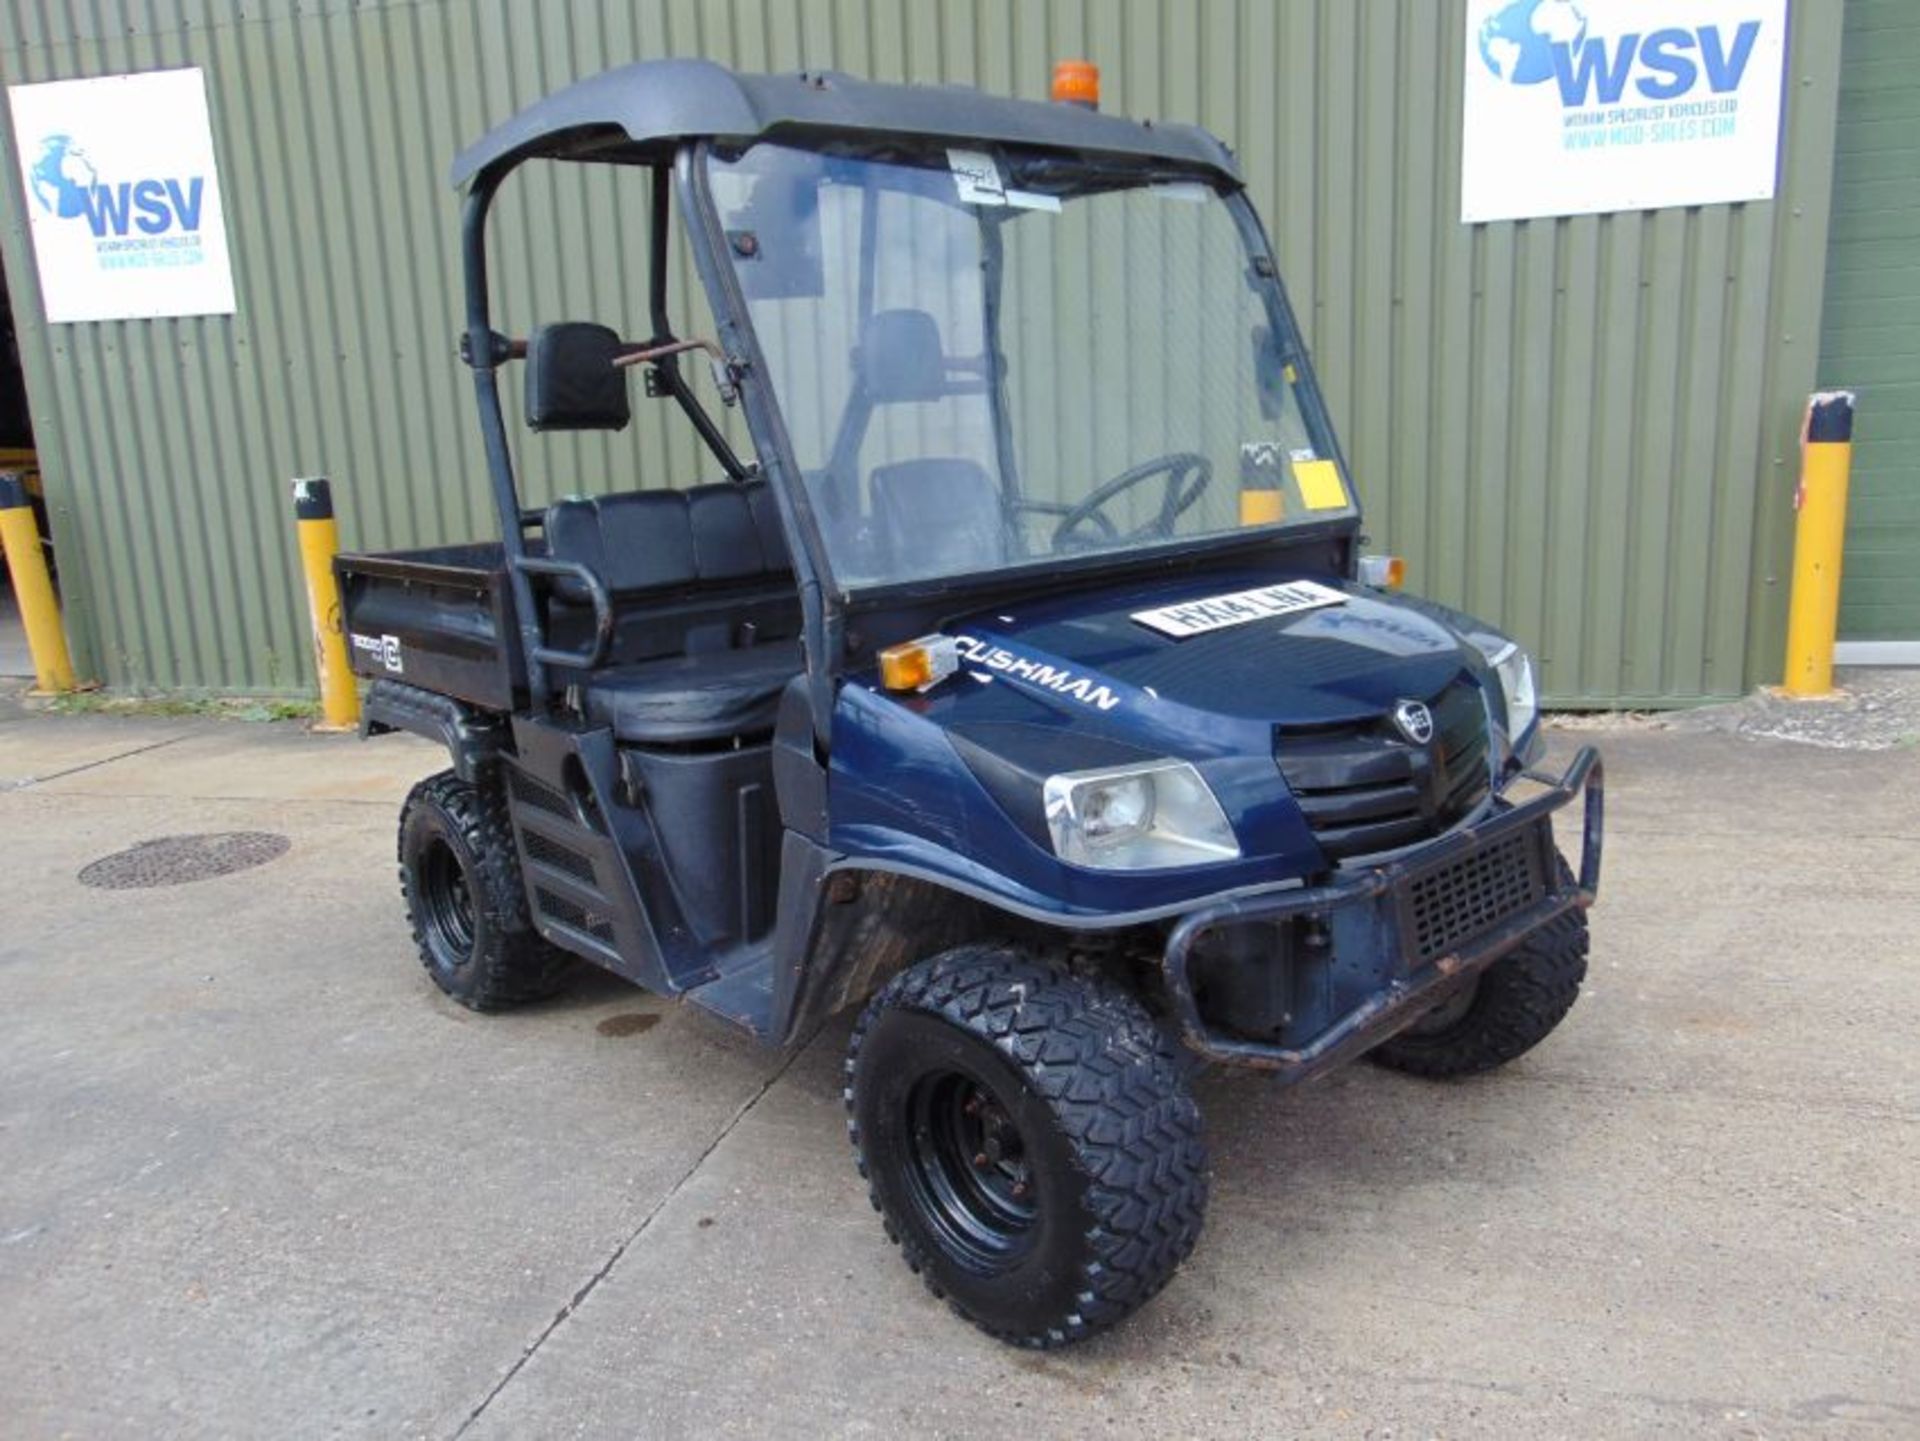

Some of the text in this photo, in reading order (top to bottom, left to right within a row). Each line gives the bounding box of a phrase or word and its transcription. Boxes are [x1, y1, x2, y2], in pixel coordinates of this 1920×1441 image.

[1551, 20, 1762, 107] WSV
[1607, 104, 1666, 125] SPECIALIST
[1668, 99, 1717, 119] VEHICLES
[84, 176, 204, 237] WSV
[1159, 600, 1258, 629] HX14
[955, 635, 1120, 711] CUSHMAN
